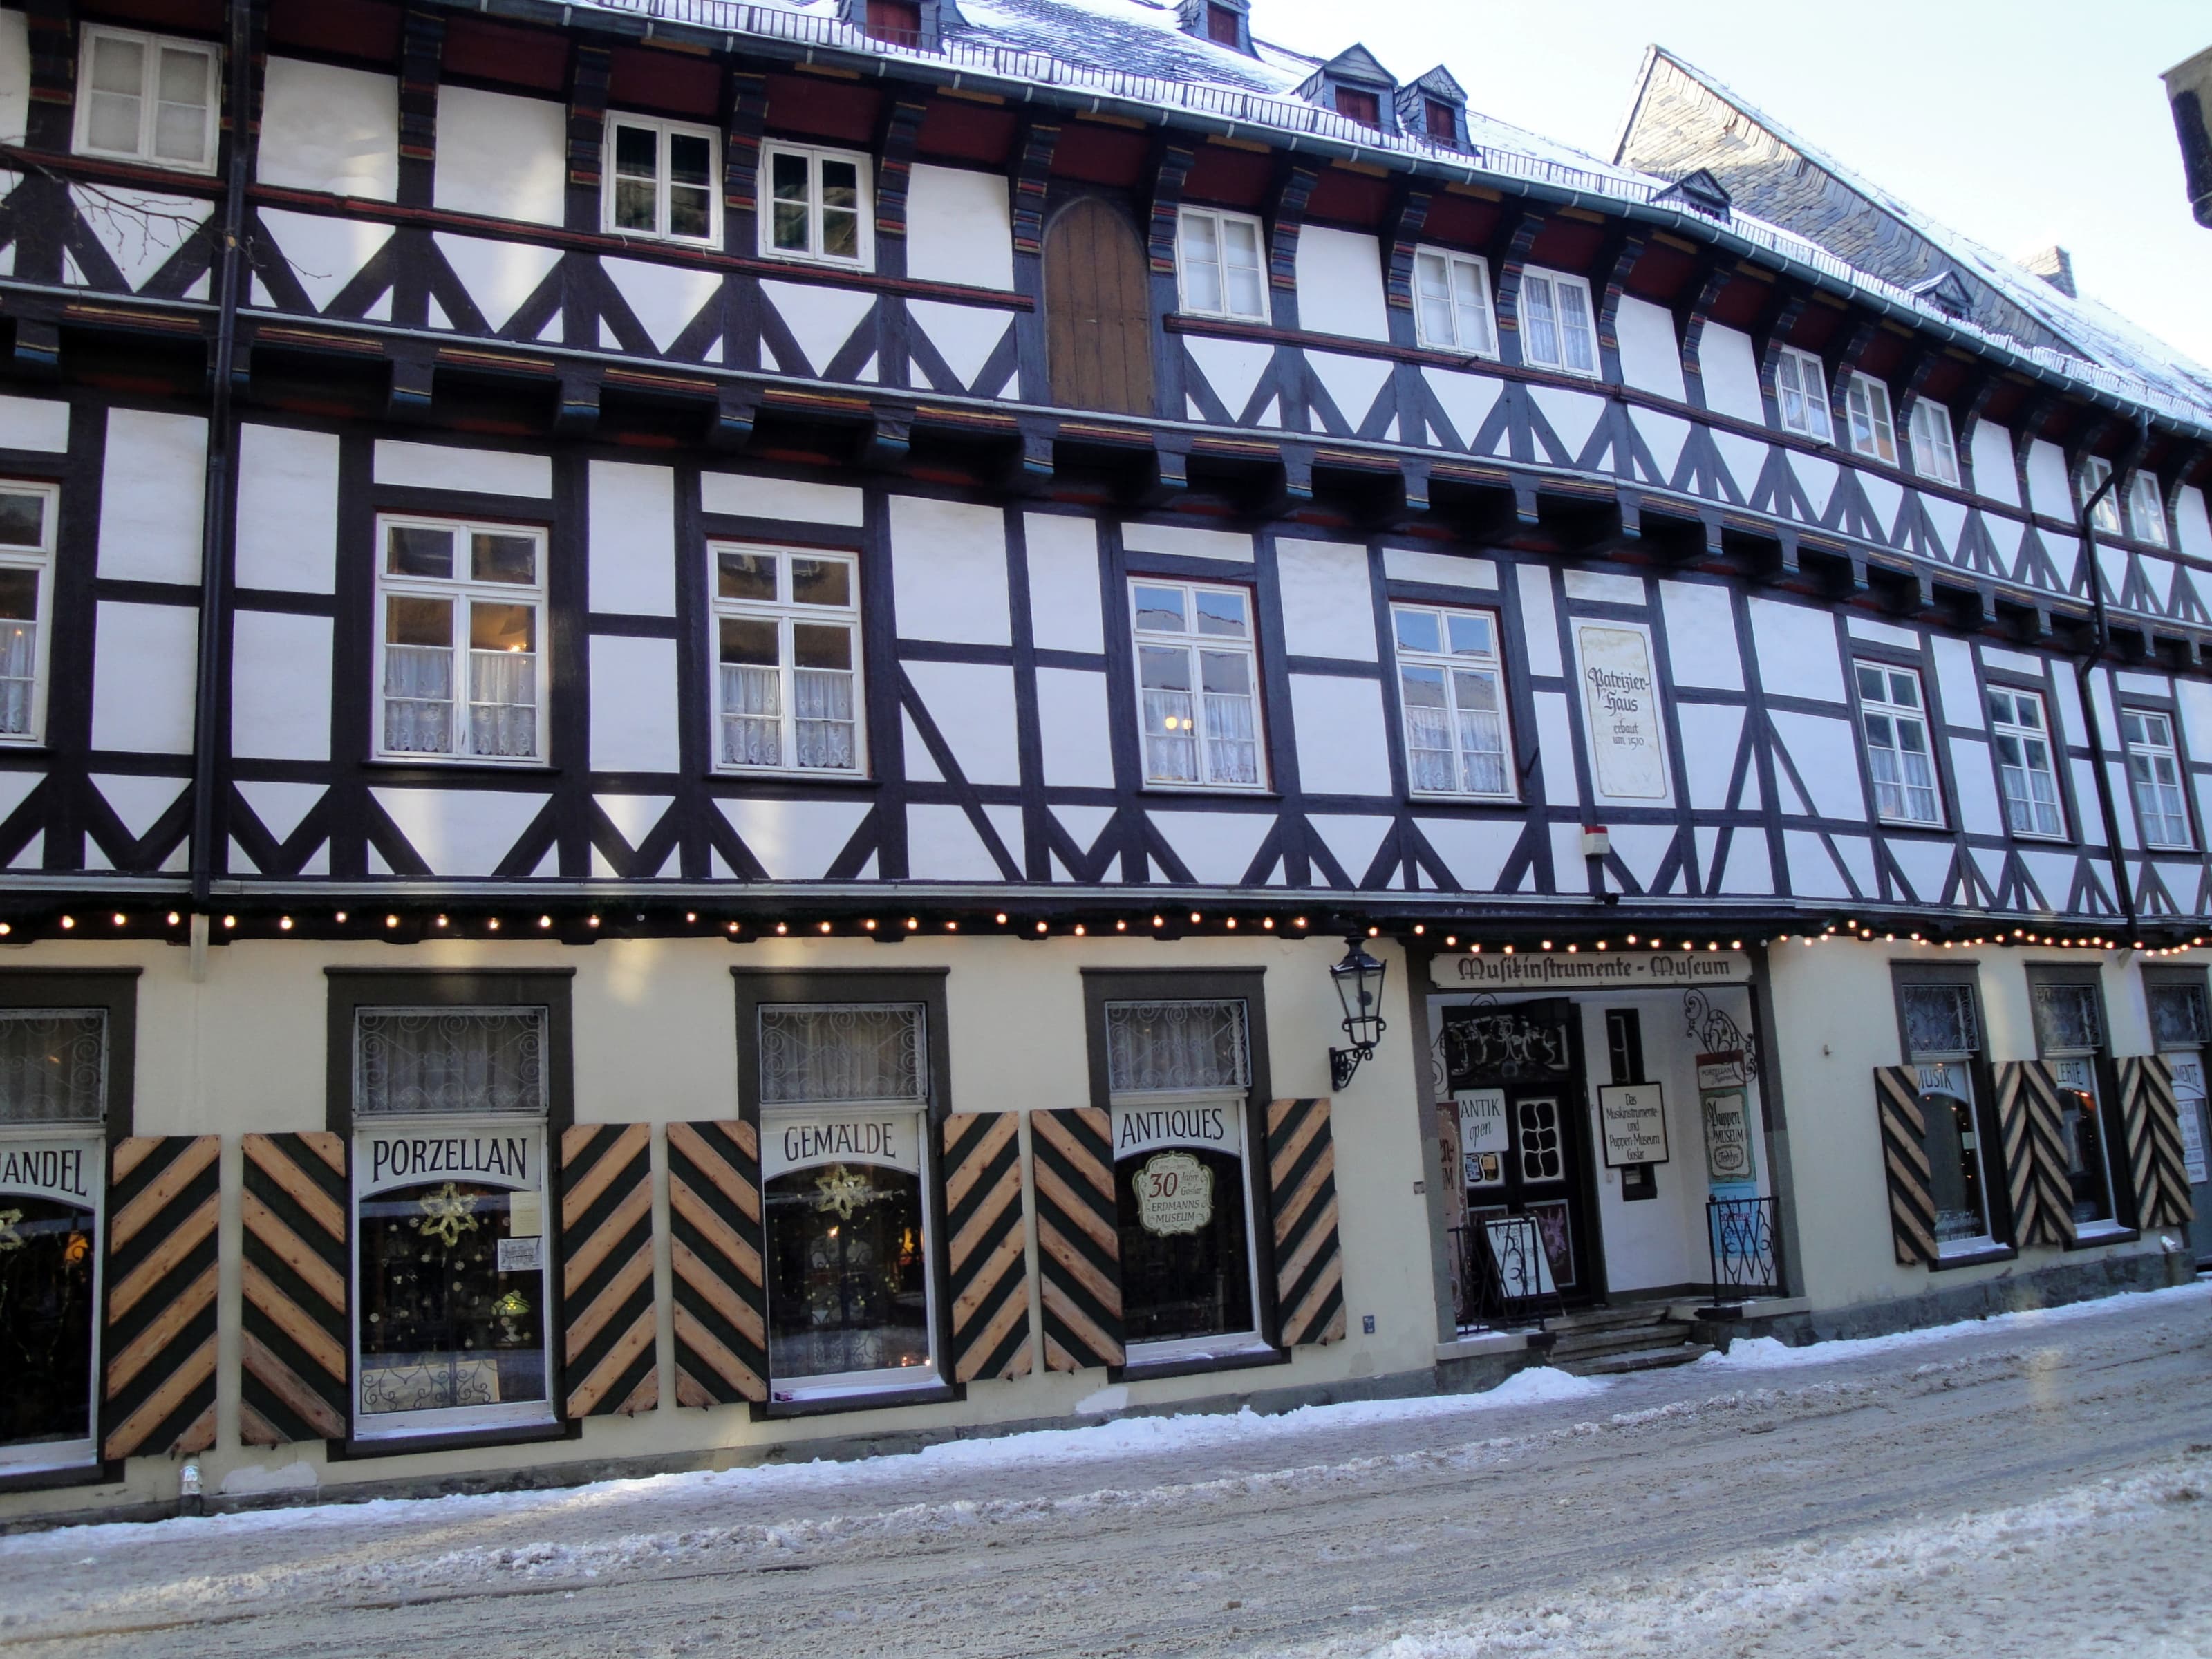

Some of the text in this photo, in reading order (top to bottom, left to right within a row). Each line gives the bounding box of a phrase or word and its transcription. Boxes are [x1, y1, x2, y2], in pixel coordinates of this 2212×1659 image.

[1587, 666, 1651, 702] Patrizier-
[1604, 690, 1639, 716] Haus
[1613, 718, 1639, 734] erbaut
[1628, 737, 1644, 750] 1510
[2054, 1062, 2083, 1085] LERIE
[1460, 1098, 1501, 1118] ANTIK
[1625, 1093, 1637, 1106] Das
[1120, 1108, 1224, 1149] ANTIQUES
[1469, 1121, 1493, 1148] open
[1627, 1119, 1640, 1132] und
[1716, 1129, 1743, 1143] MUSEUM
[784, 1123, 896, 1161] GEMÄLDE
[372, 1138, 527, 1183] PORZELLAN
[1627, 1147, 1644, 1161] Goslar
[0, 1150, 88, 1197] ANDEL
[1148, 1172, 1179, 1198] 30
[1152, 1200, 1200, 1212] ERDMANNS
[1155, 1212, 1195, 1224] MUSEUM
